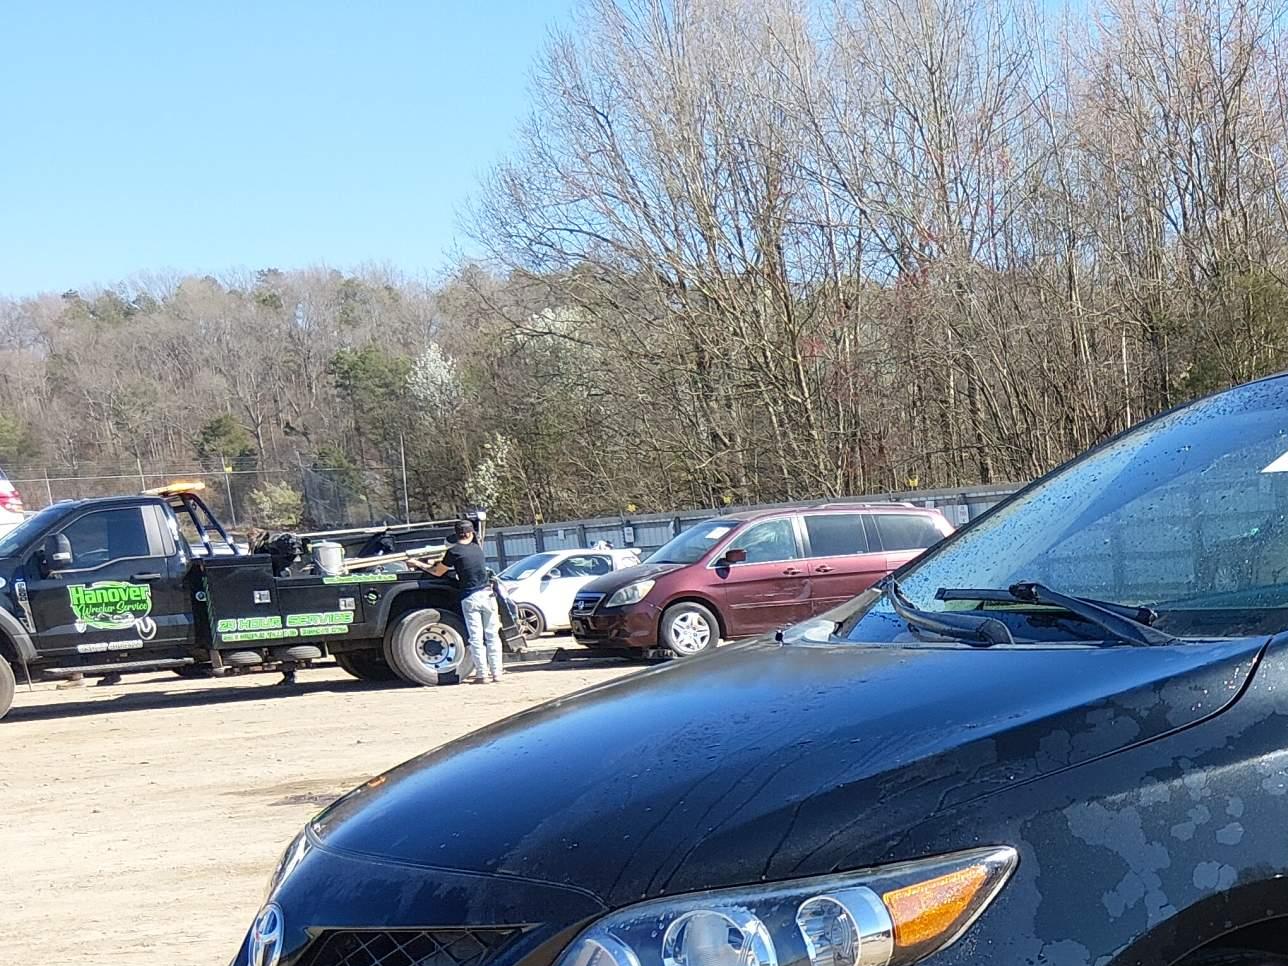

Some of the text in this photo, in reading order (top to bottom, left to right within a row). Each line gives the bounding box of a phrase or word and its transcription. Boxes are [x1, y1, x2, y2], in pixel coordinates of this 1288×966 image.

[69, 584, 150, 605] Hanover
[80, 601, 148, 617] Wrecker Service
[238, 616, 282, 631] HOUR
[287, 611, 354, 627] SERVICE
